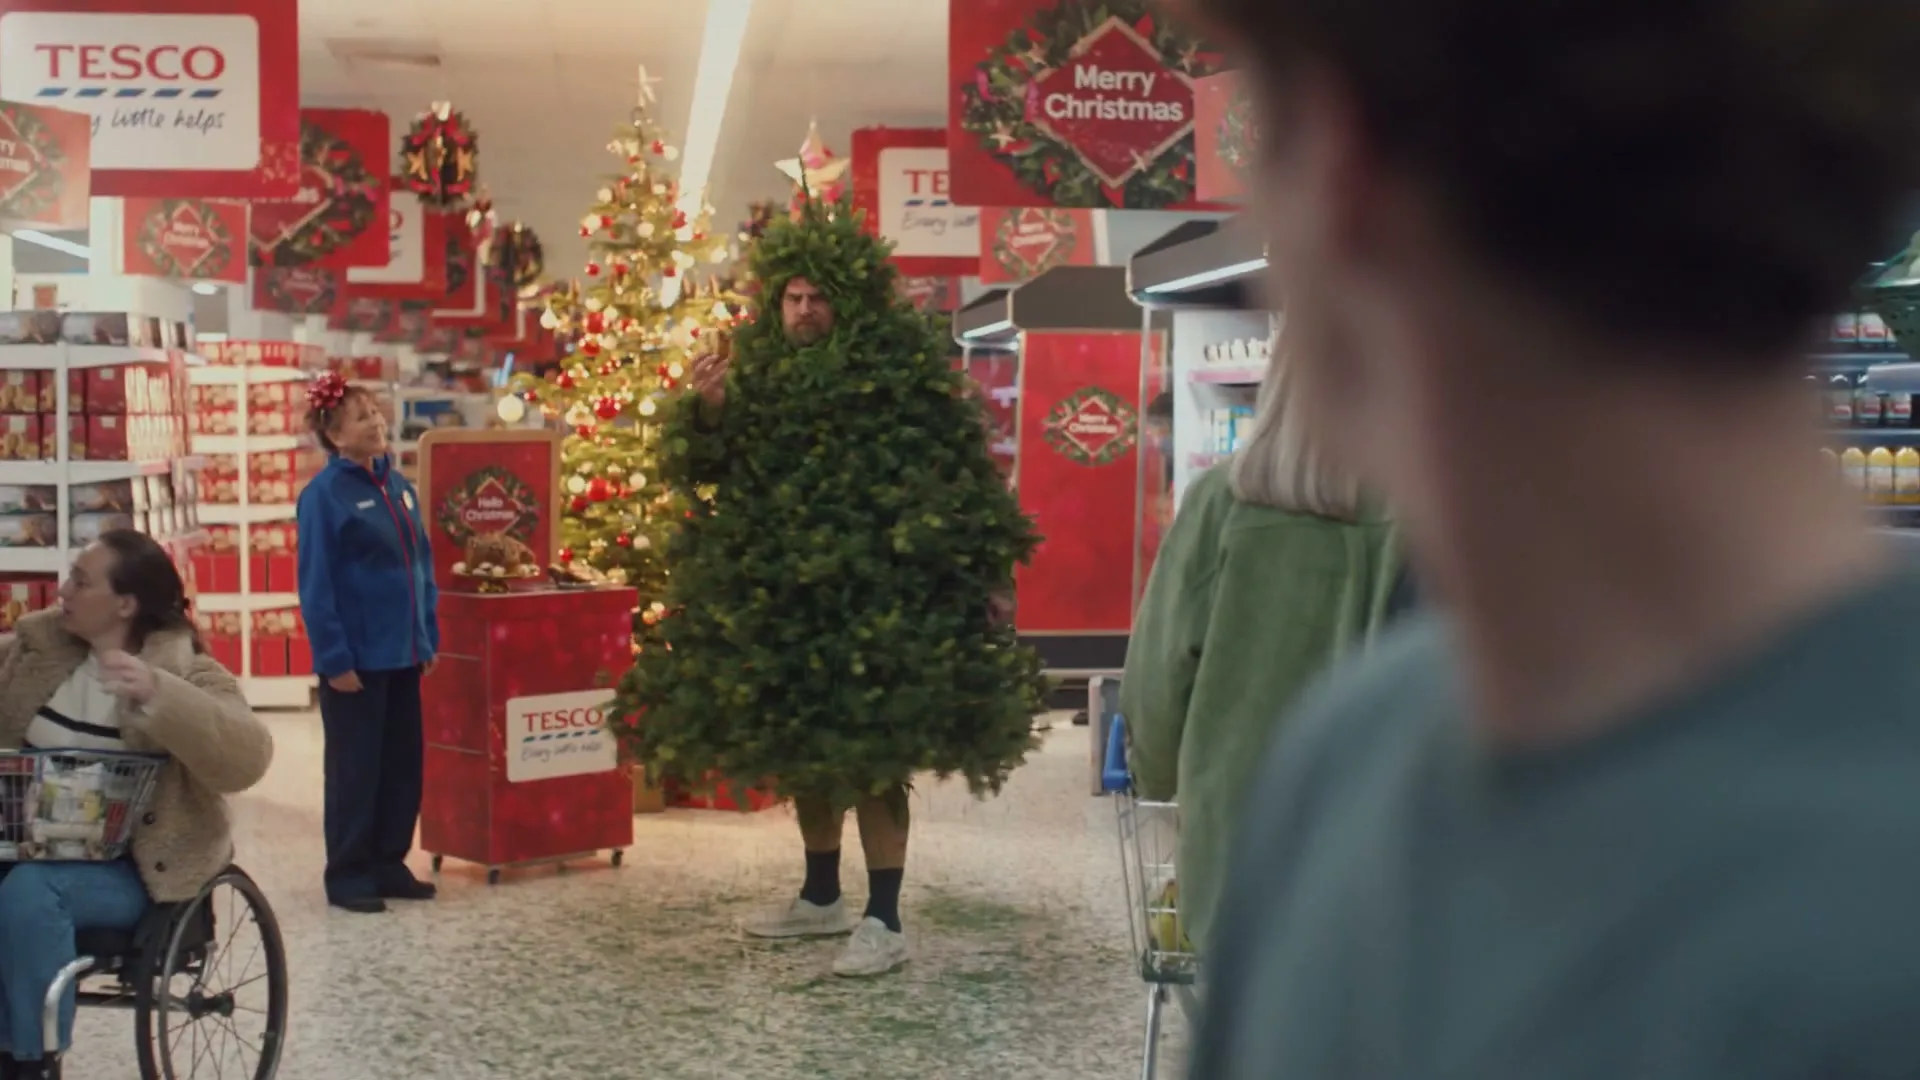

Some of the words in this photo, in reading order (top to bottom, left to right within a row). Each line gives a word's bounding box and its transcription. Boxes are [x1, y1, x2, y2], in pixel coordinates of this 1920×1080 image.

[34, 44, 226, 81] TESCO
[1074, 64, 1156, 97] Merry
[1044, 93, 1184, 122] Christmas
[173, 108, 226, 137] helps
[902, 169, 949, 195] TE
[521, 707, 604, 733] TESCO
